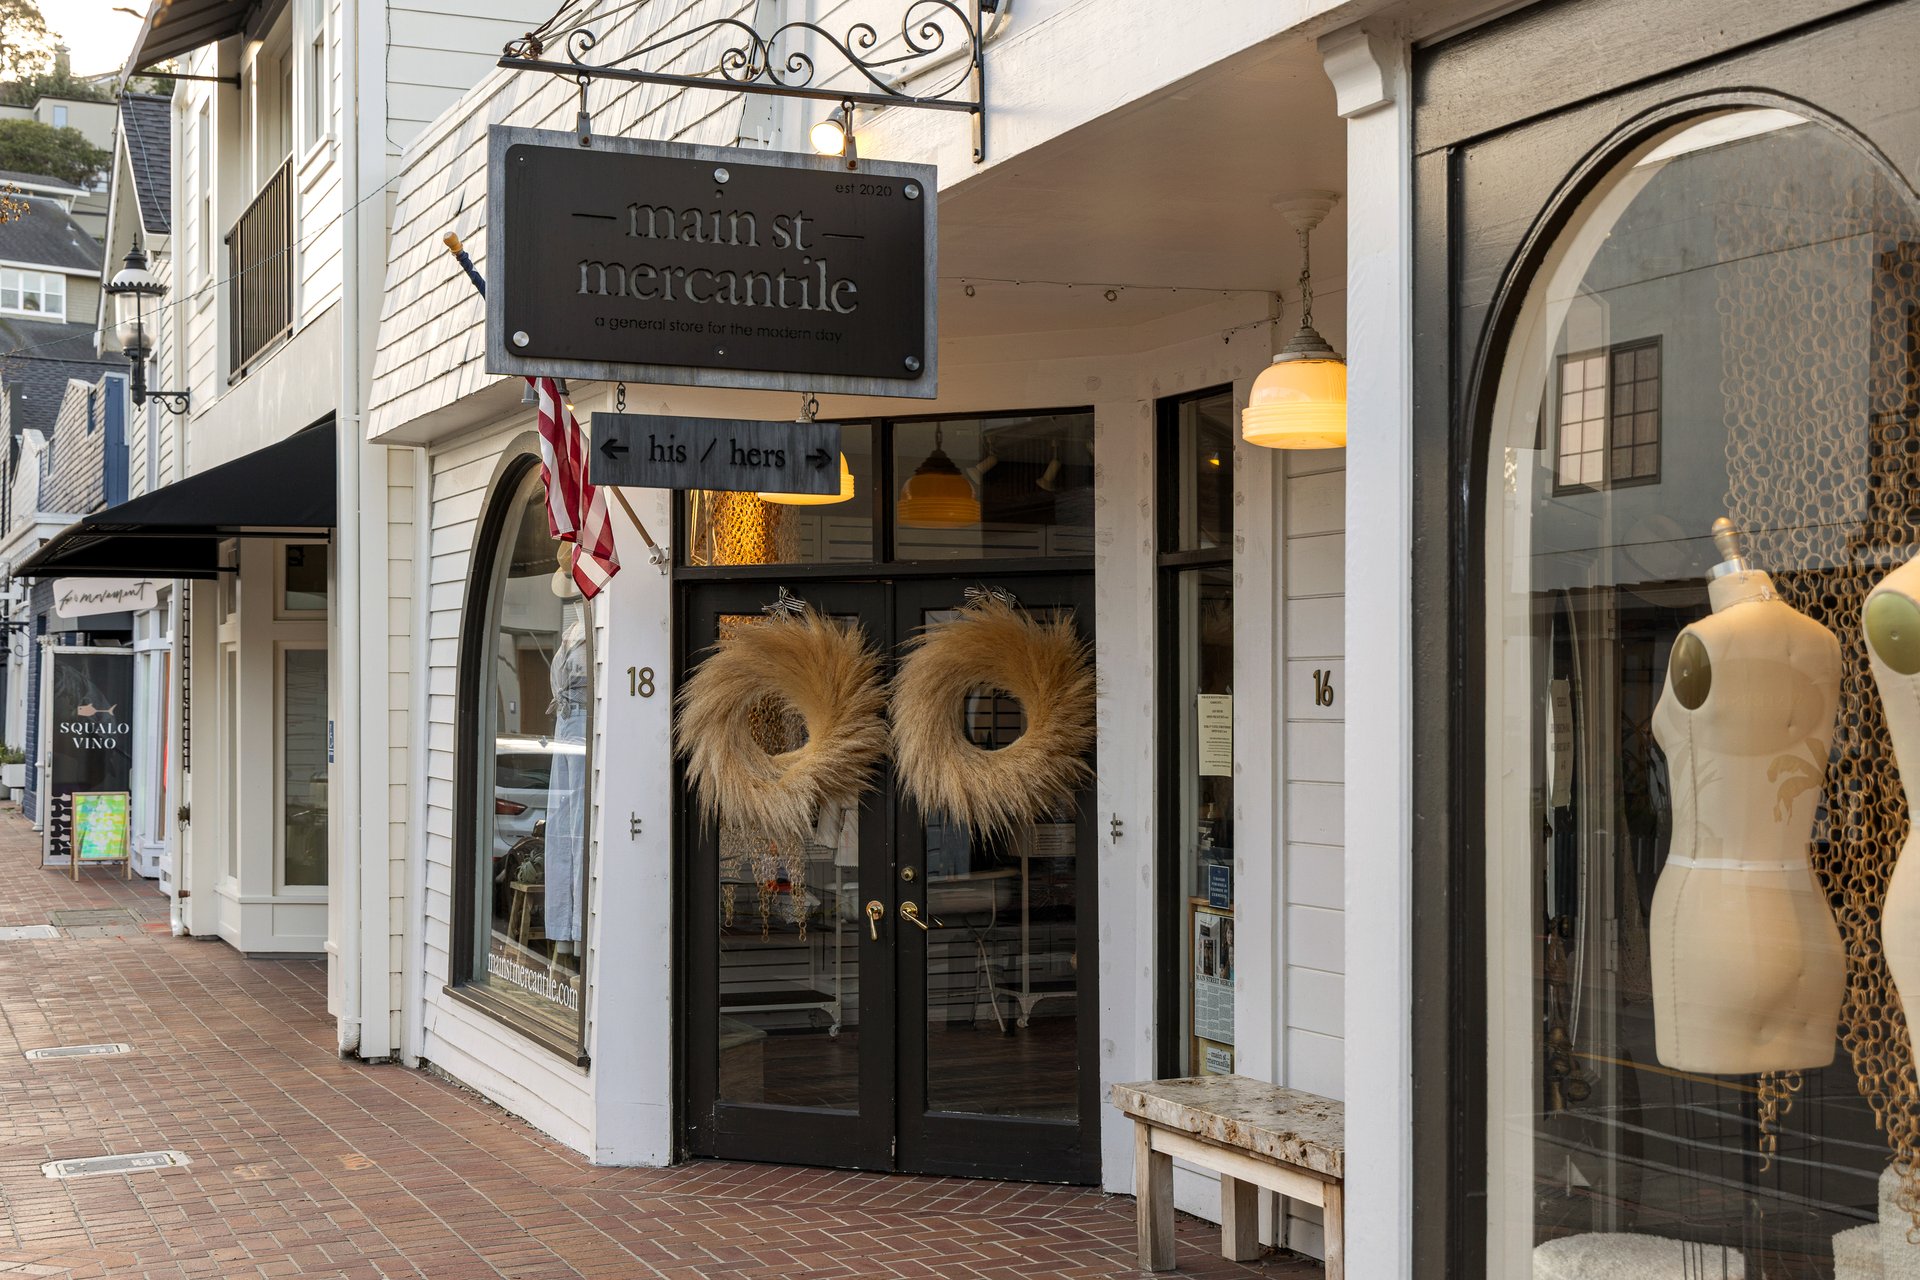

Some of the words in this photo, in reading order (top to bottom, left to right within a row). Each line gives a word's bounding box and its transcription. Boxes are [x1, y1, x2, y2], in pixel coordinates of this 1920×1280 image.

[835, 184, 855, 195] est
[860, 184, 893, 197] 2020
[625, 188, 761, 247] main
[772, 210, 815, 251] st
[576, 255, 860, 315] mercantile
[594, 316, 605, 327] a
[608, 318, 667, 331] general
[669, 320, 704, 334] store
[707, 320, 727, 335] for
[730, 321, 753, 337] the
[757, 325, 812, 340] modern
[815, 328, 843, 345] day
[648, 433, 688, 464] his
[729, 437, 787, 468] hers
[626, 666, 656, 698] 18
[1312, 669, 1335, 707] 16
[59, 721, 130, 735] SQUALO
[72, 737, 117, 750] VINO
[487, 945, 579, 1012] mainstmercantile.com
